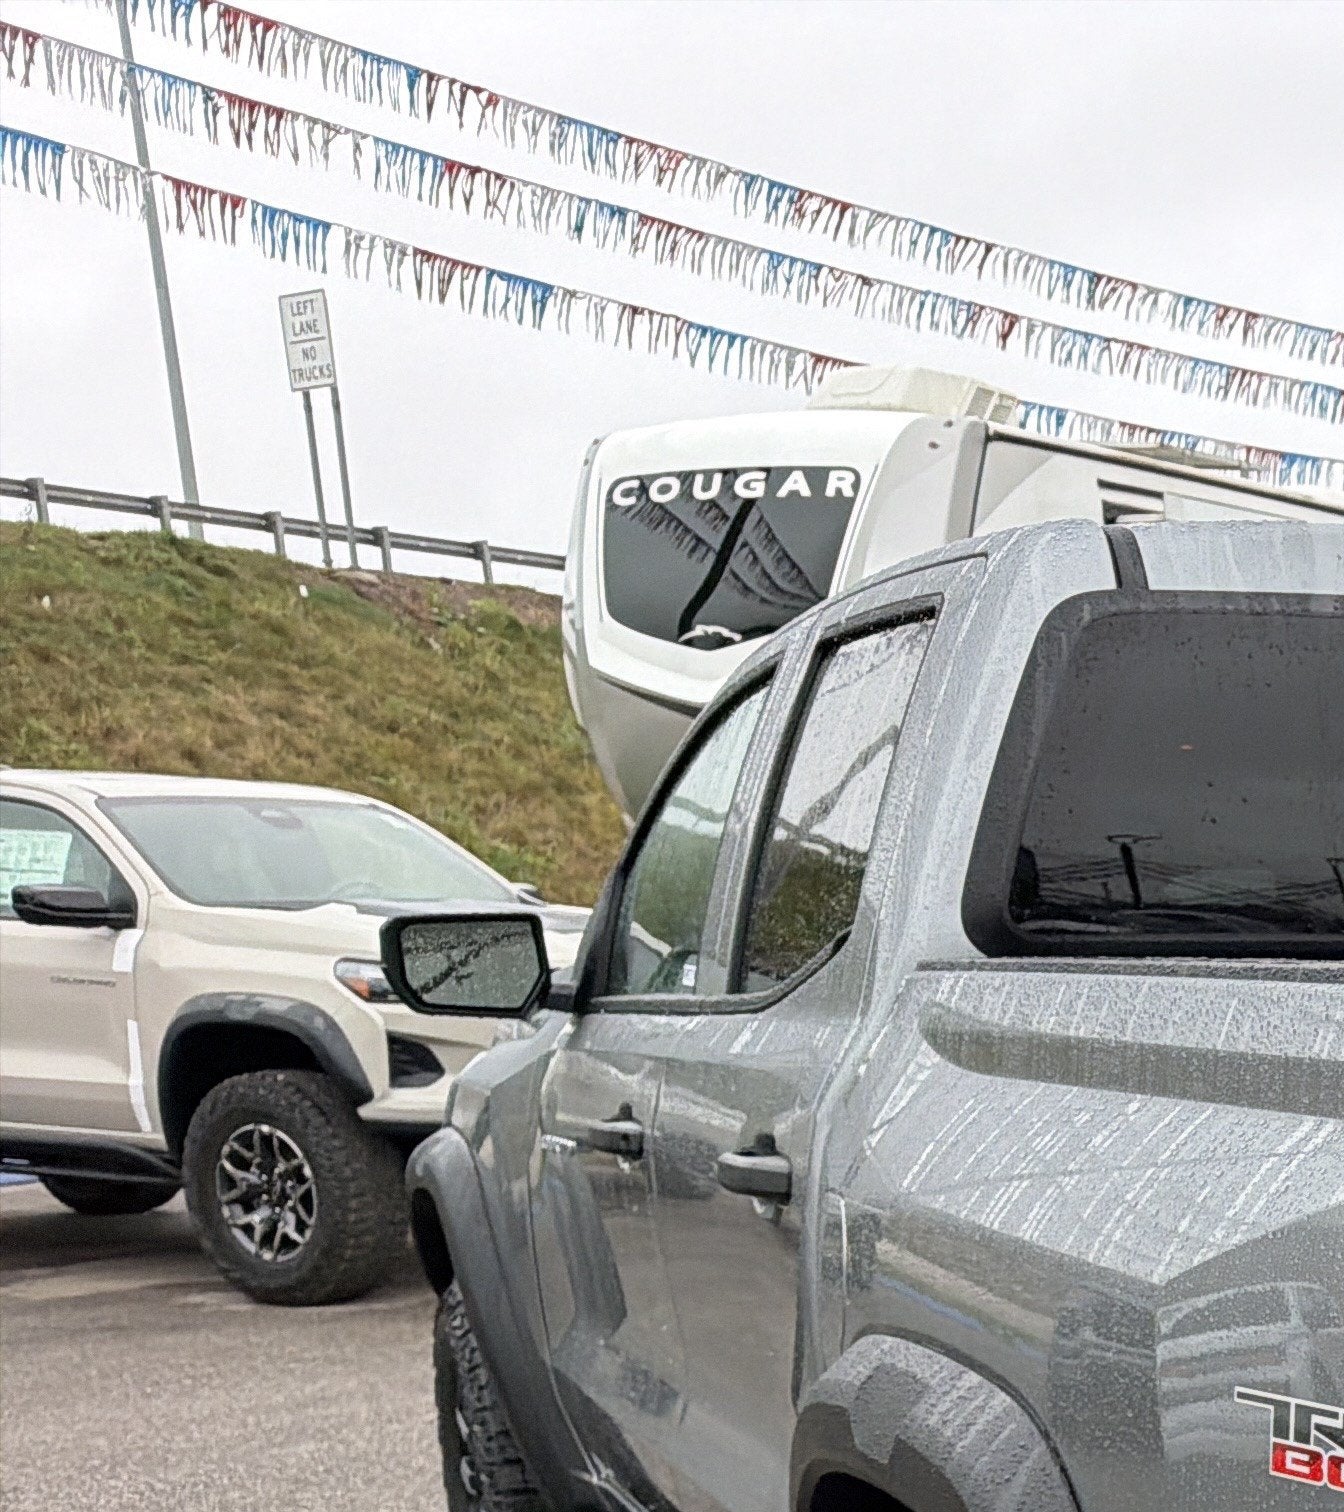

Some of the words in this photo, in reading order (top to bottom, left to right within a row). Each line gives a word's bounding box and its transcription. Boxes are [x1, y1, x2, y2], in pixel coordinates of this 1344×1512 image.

[290, 299, 315, 317] LEFT
[292, 319, 319, 337] LANE
[302, 345, 316, 361] NO
[291, 363, 332, 383] TRUCKS
[612, 470, 854, 506] COUGAR
